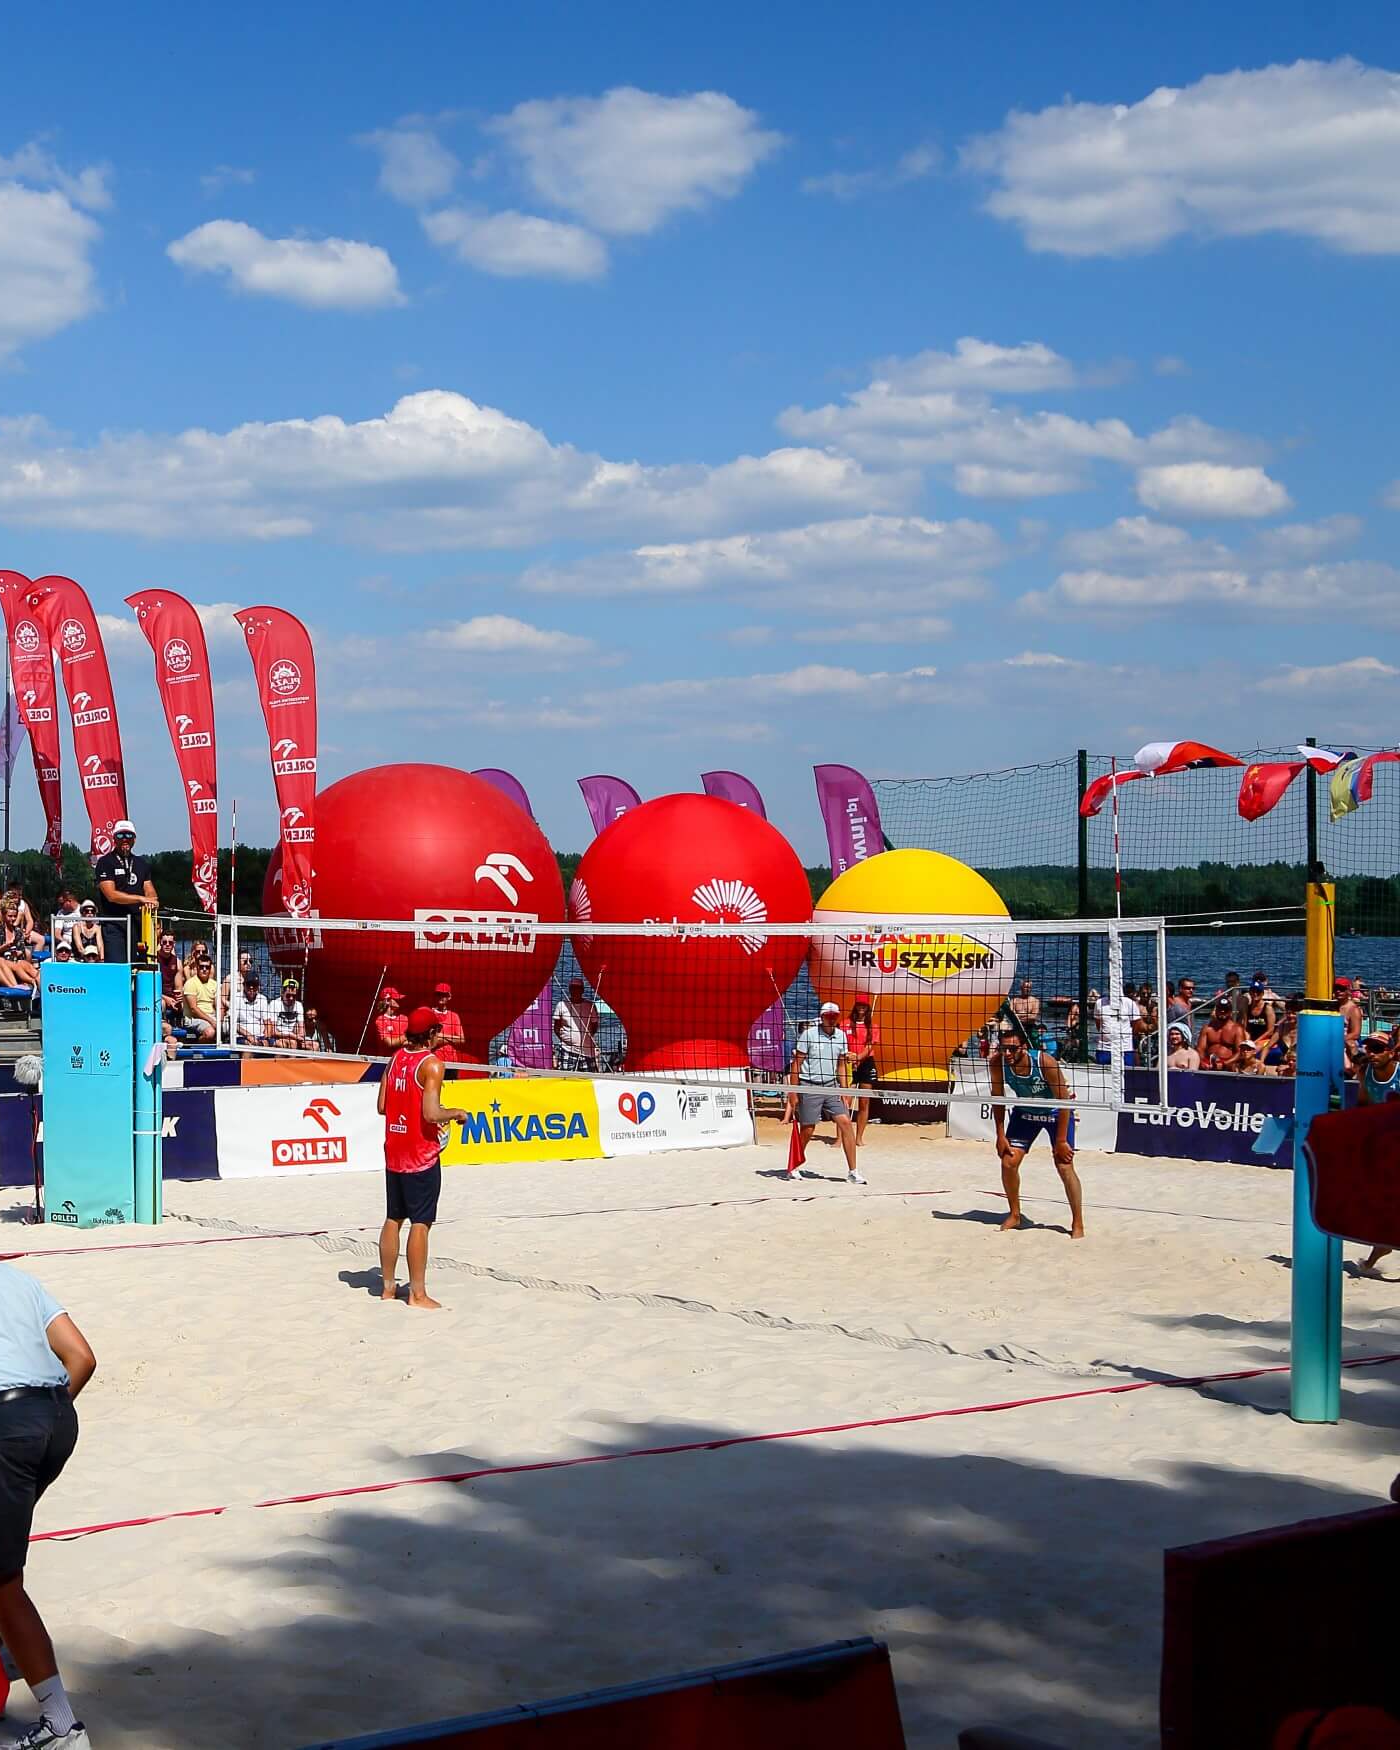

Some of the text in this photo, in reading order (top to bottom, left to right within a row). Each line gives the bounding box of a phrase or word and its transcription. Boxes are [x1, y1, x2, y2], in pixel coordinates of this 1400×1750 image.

[848, 948, 994, 974] PRUSZYŃSKI
[56, 985, 87, 994] Senoh
[461, 1111, 589, 1144] MIKASA
[1133, 1097, 1285, 1134] EuroVolle
[275, 1140, 343, 1163] ORLEN
[52, 1214, 77, 1222] ORLEN
